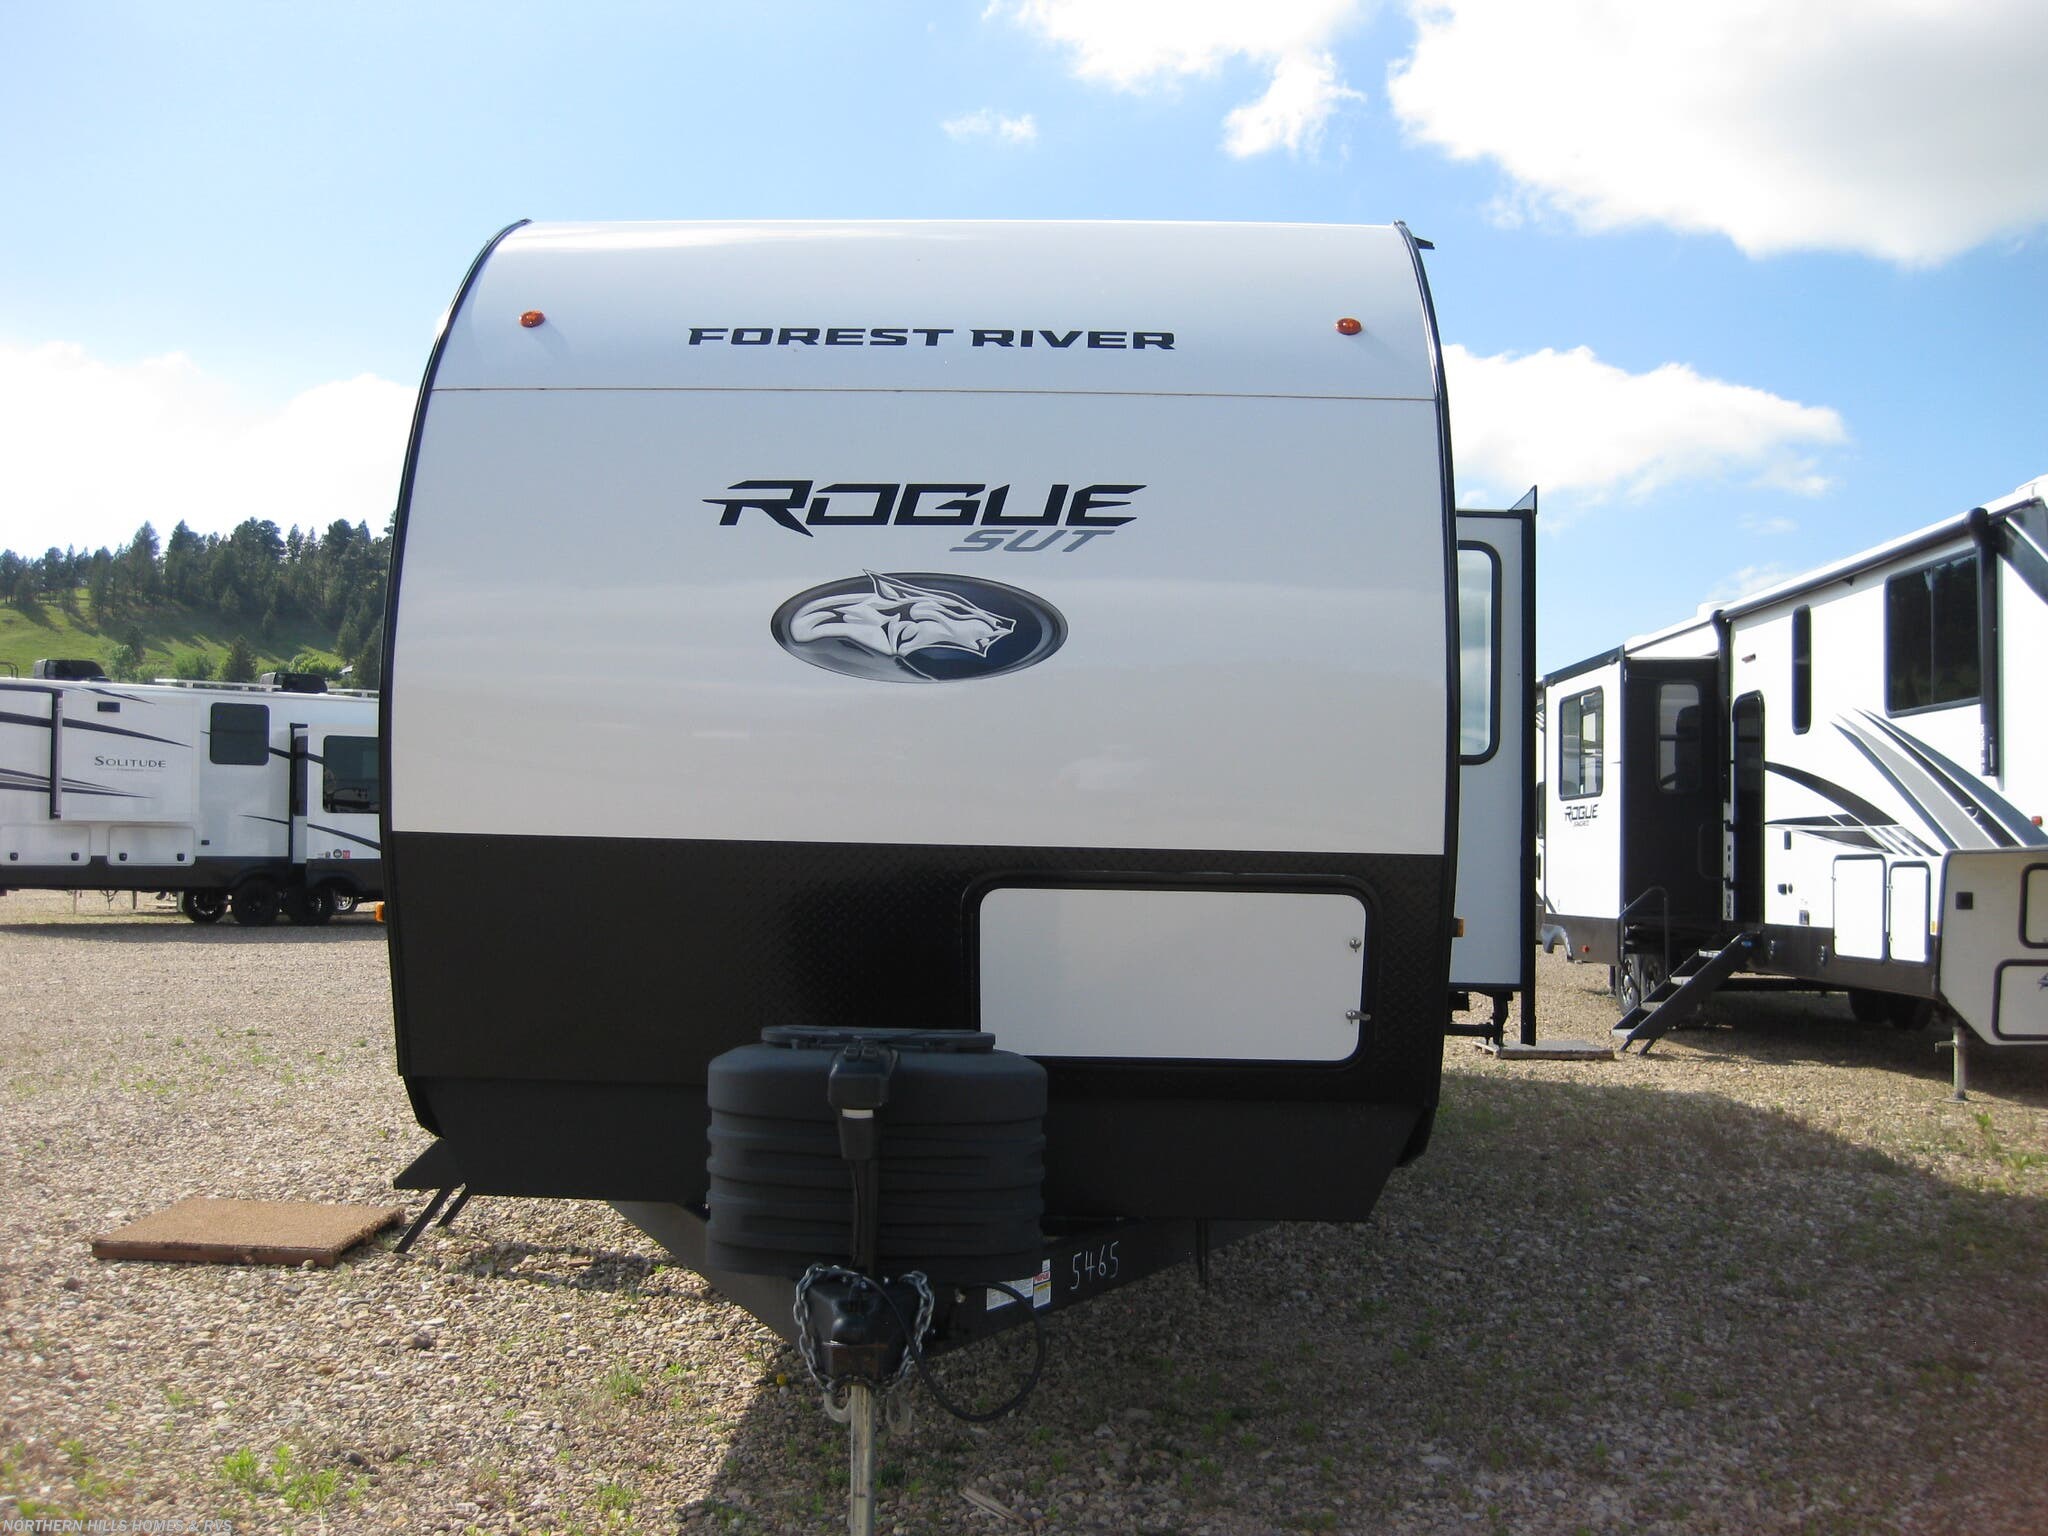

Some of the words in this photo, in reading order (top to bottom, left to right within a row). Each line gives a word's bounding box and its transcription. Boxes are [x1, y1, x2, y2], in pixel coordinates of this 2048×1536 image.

[688, 327, 954, 347] FOREST
[970, 328, 1176, 350] RIVER
[701, 479, 1148, 538] ROGUE
[949, 529, 1116, 553] SUT
[94, 755, 167, 768] SOLITUDE
[1564, 803, 1599, 823] ROGUE
[1069, 1240, 1120, 1291] 5465
